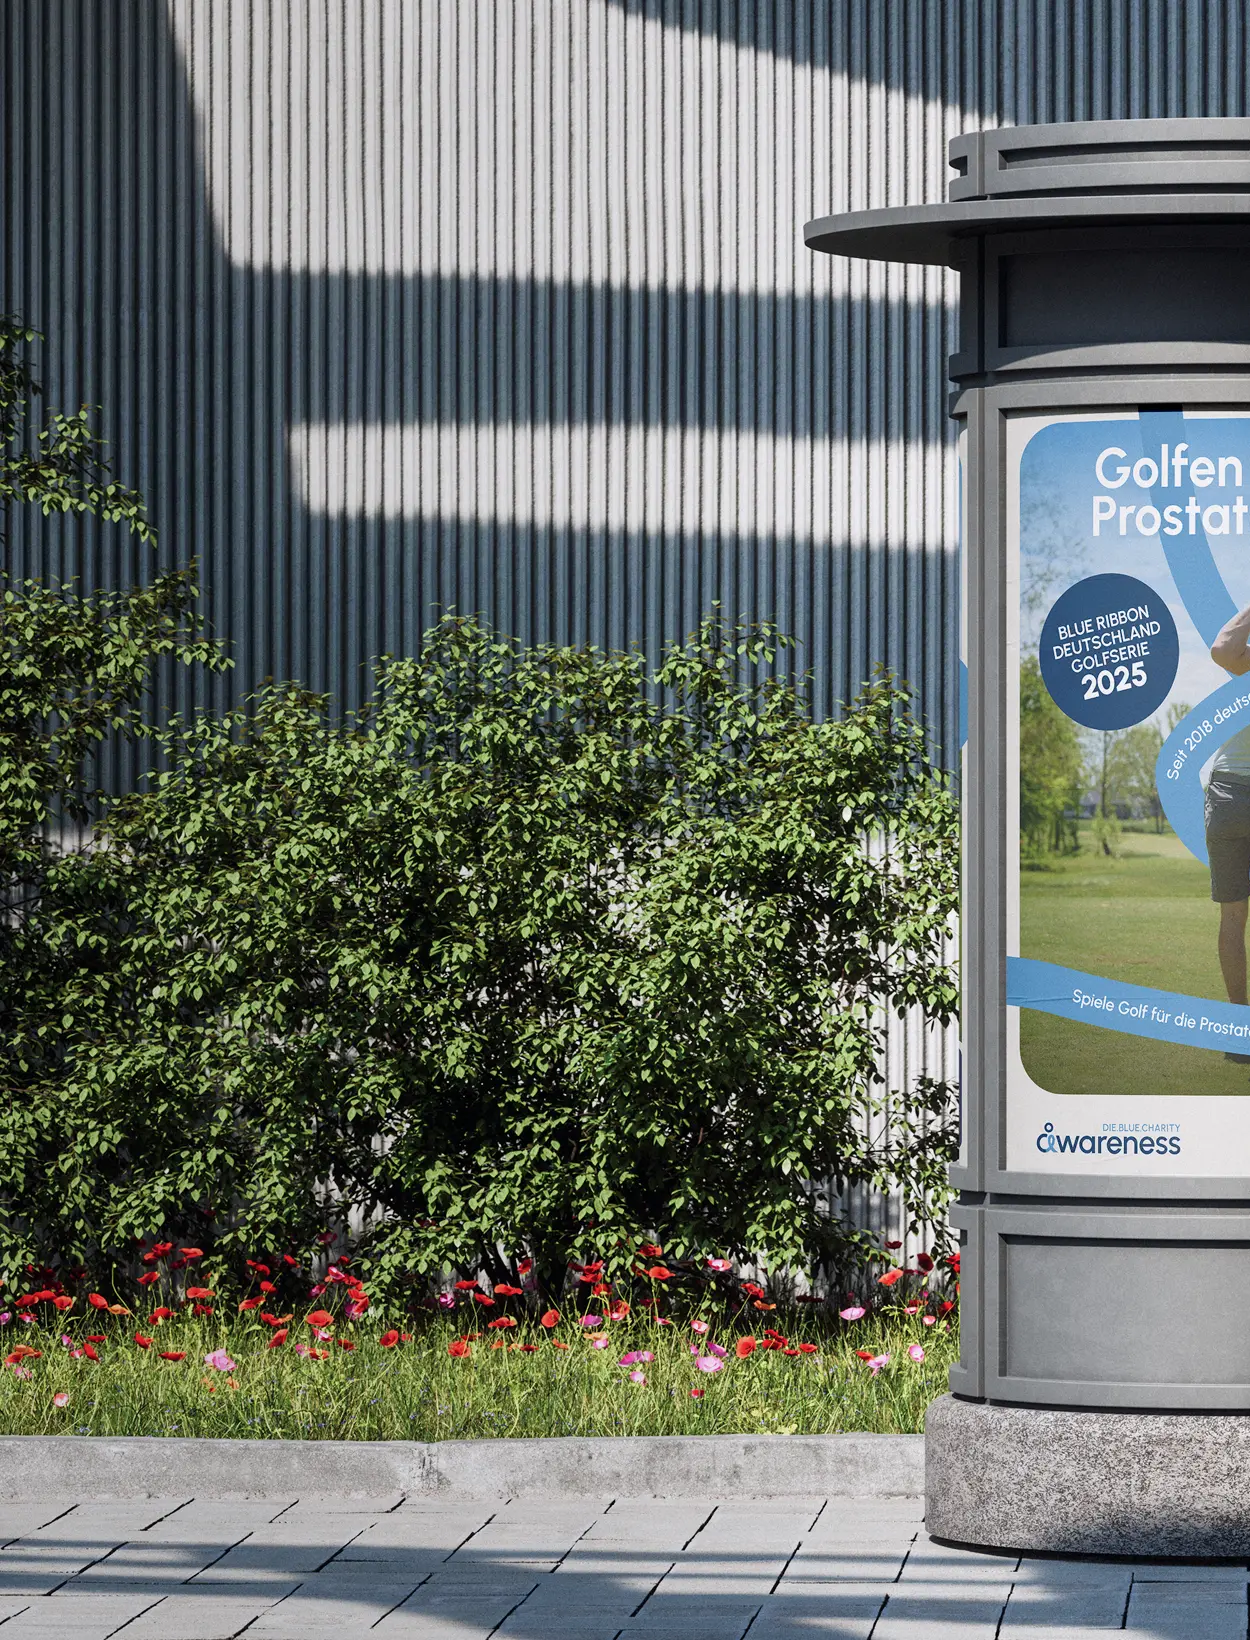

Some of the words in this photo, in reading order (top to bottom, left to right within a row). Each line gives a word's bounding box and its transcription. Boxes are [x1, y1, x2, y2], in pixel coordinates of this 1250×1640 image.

[1095, 442, 1243, 489] Golfen
[1052, 621, 1161, 660] DEUTSCHLAND
[1058, 619, 1095, 640] BLUE
[1096, 604, 1150, 631] RIBBON
[1071, 641, 1150, 673] GOLFSERIE
[1081, 661, 1148, 700] 2025
[1166, 749, 1188, 780] Seit
[1184, 720, 1213, 751] 2018
[1072, 989, 1115, 1012] Spiele
[1118, 1001, 1148, 1019] Golf
[1151, 1007, 1172, 1024] für
[1174, 1012, 1197, 1029] die
[1102, 1123, 1181, 1132] DIE.BLUE.CHARITY
